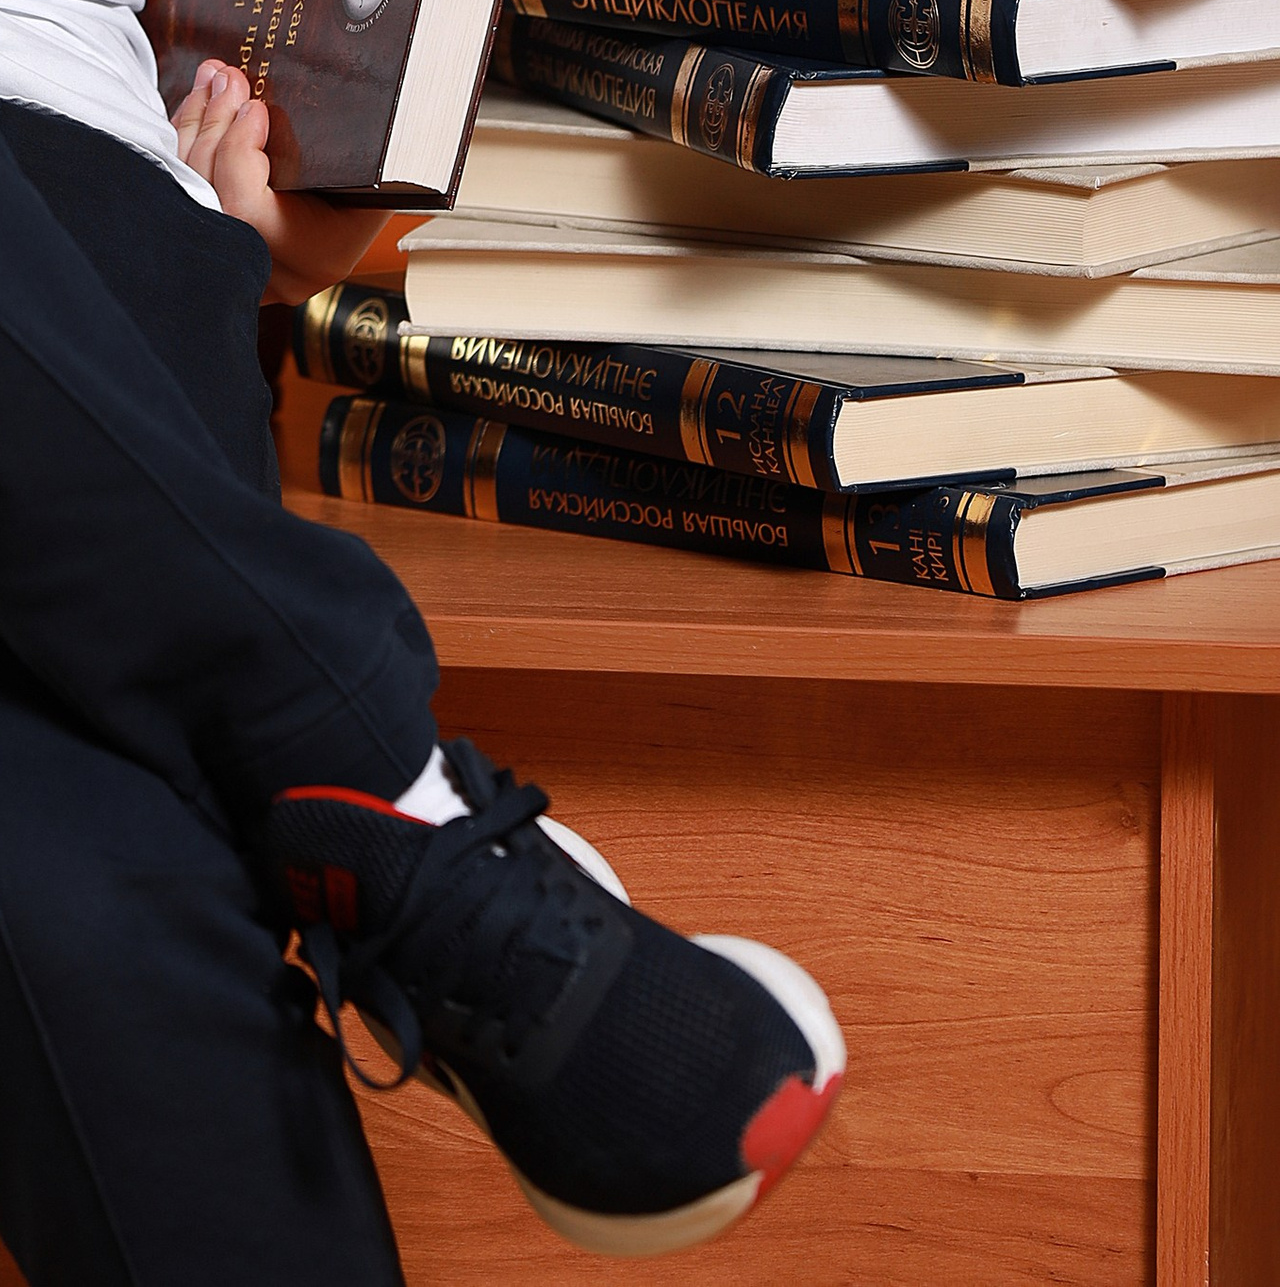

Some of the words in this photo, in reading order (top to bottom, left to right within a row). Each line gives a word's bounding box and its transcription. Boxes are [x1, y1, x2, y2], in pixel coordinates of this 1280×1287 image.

[450, 336, 659, 401] ЭНЦИКЛОПЕДИЯ
[450, 371, 565, 416] РОССИЙСКАЯ
[570, 396, 654, 435] БОЛЬШАЯ
[716, 389, 747, 444] 12
[749, 378, 775, 475] ИСЛАНД
[531, 444, 789, 514] ЭНЦИКЛОПЕДИЯ
[528, 487, 673, 530] РОССИЙСКАЯ
[682, 511, 788, 547] БОЛЬШАЯ
[869, 503, 900, 555] 13
